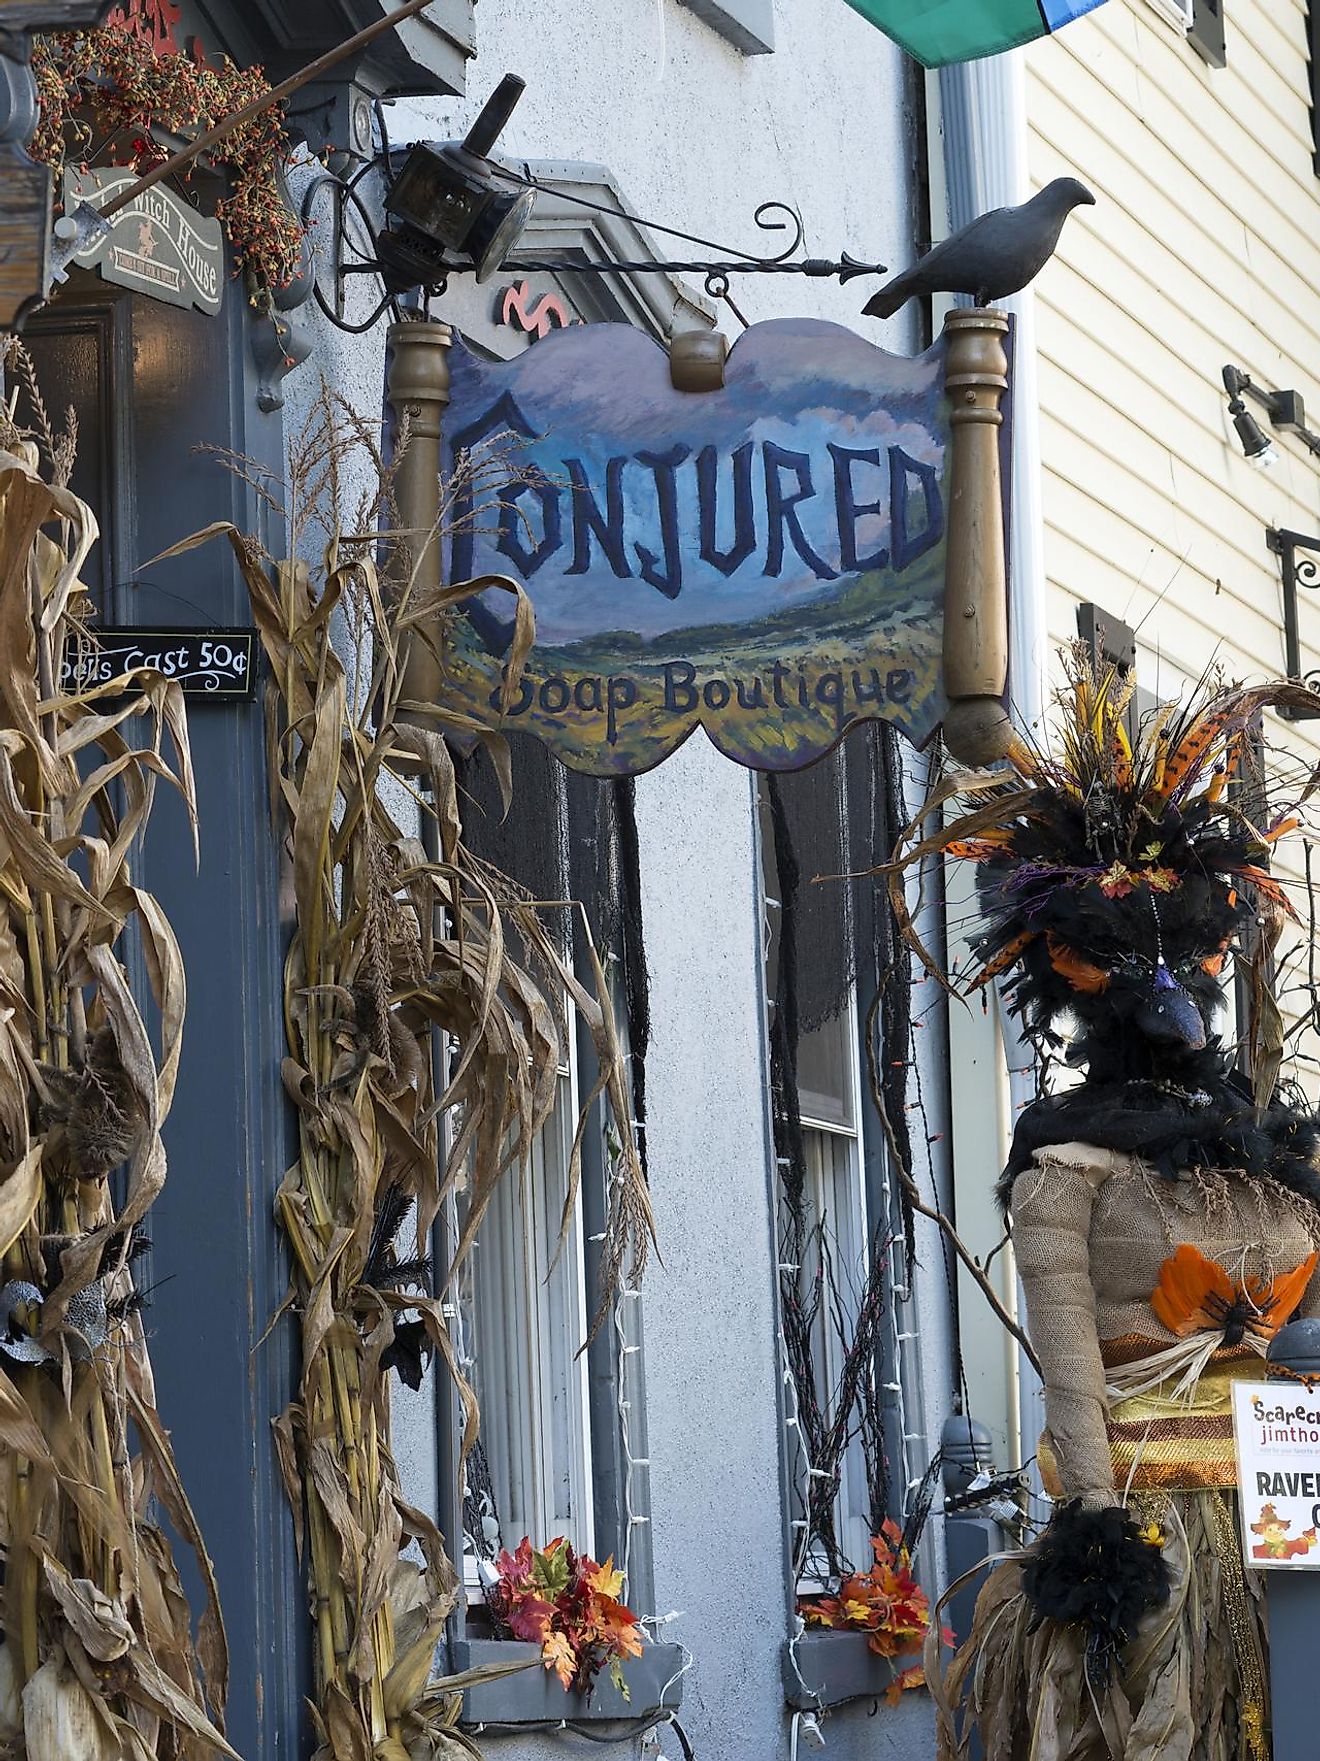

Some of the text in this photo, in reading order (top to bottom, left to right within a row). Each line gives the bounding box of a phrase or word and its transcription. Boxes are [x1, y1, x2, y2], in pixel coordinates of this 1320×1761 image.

[176, 216, 217, 296] House
[450, 391, 945, 658] CONJURED
[199, 642, 248, 676] 50¢
[489, 659, 915, 746] Soap Boutique
